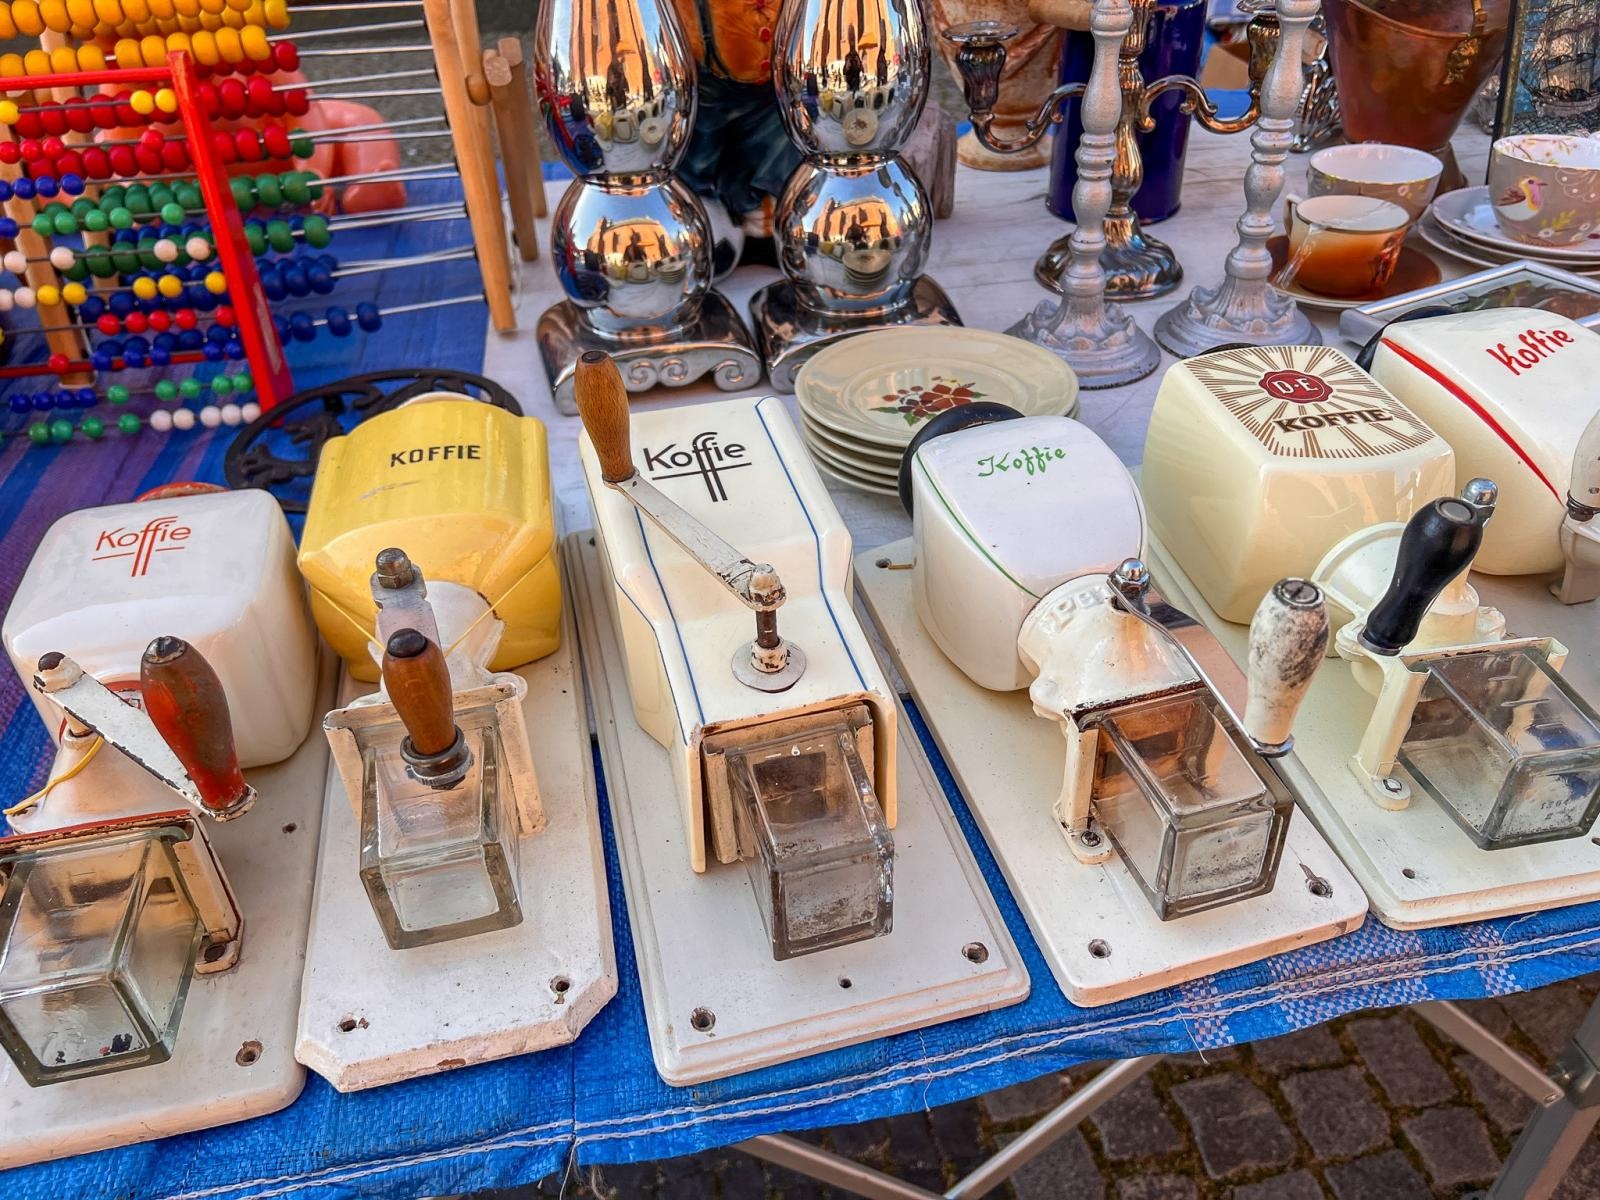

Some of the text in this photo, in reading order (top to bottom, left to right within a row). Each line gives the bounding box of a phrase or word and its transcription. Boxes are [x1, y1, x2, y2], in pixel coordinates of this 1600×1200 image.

[1486, 329, 1574, 376] Koffie
[1274, 409, 1393, 433] KOFFIE
[391, 445, 481, 467] KOFFIE
[643, 432, 752, 502] Koffie
[977, 446, 1066, 477] Koffie
[93, 516, 192, 577] Koffie
